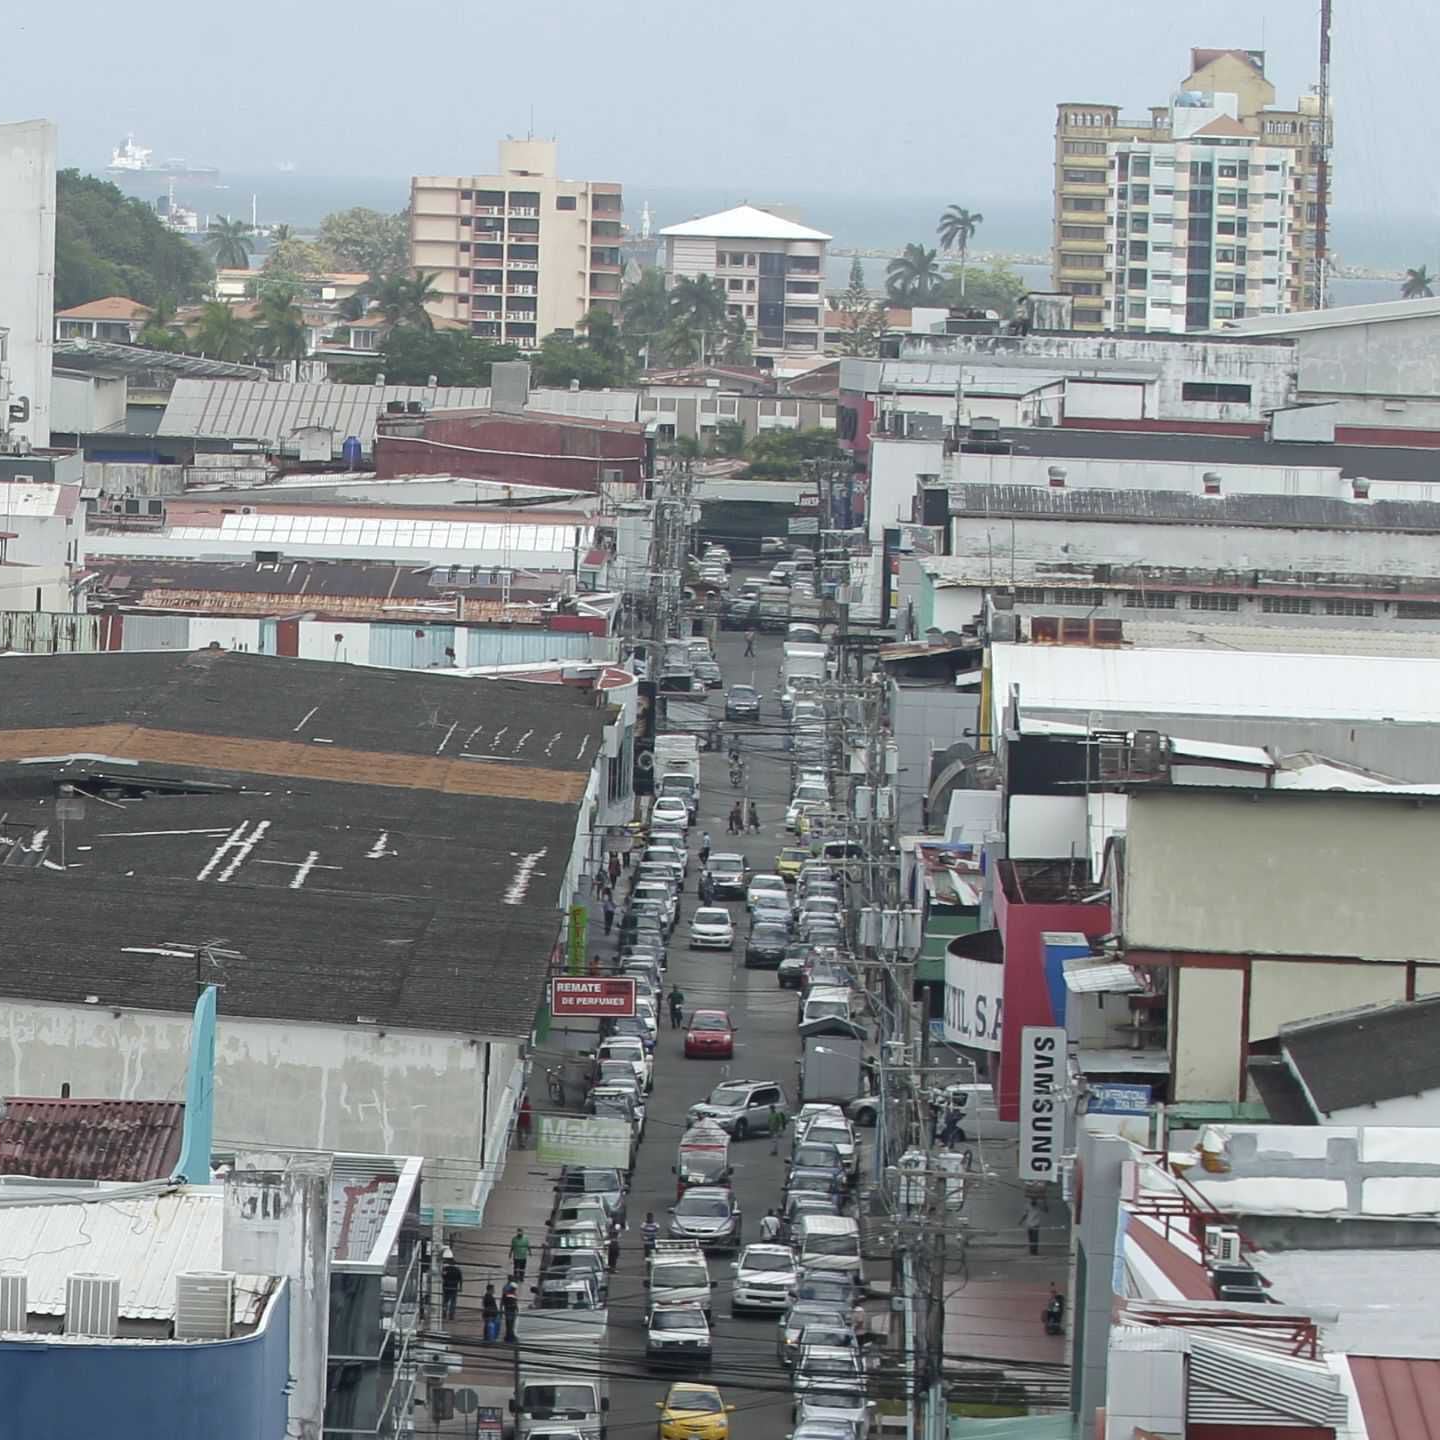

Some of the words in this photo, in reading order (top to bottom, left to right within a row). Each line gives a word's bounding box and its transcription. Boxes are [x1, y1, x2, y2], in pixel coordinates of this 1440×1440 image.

[556, 982, 602, 993] REMATE
[561, 997, 575, 1006] DE
[576, 997, 625, 1007] PERFUMES
[1030, 1035, 1056, 1174] SAMSUNG
